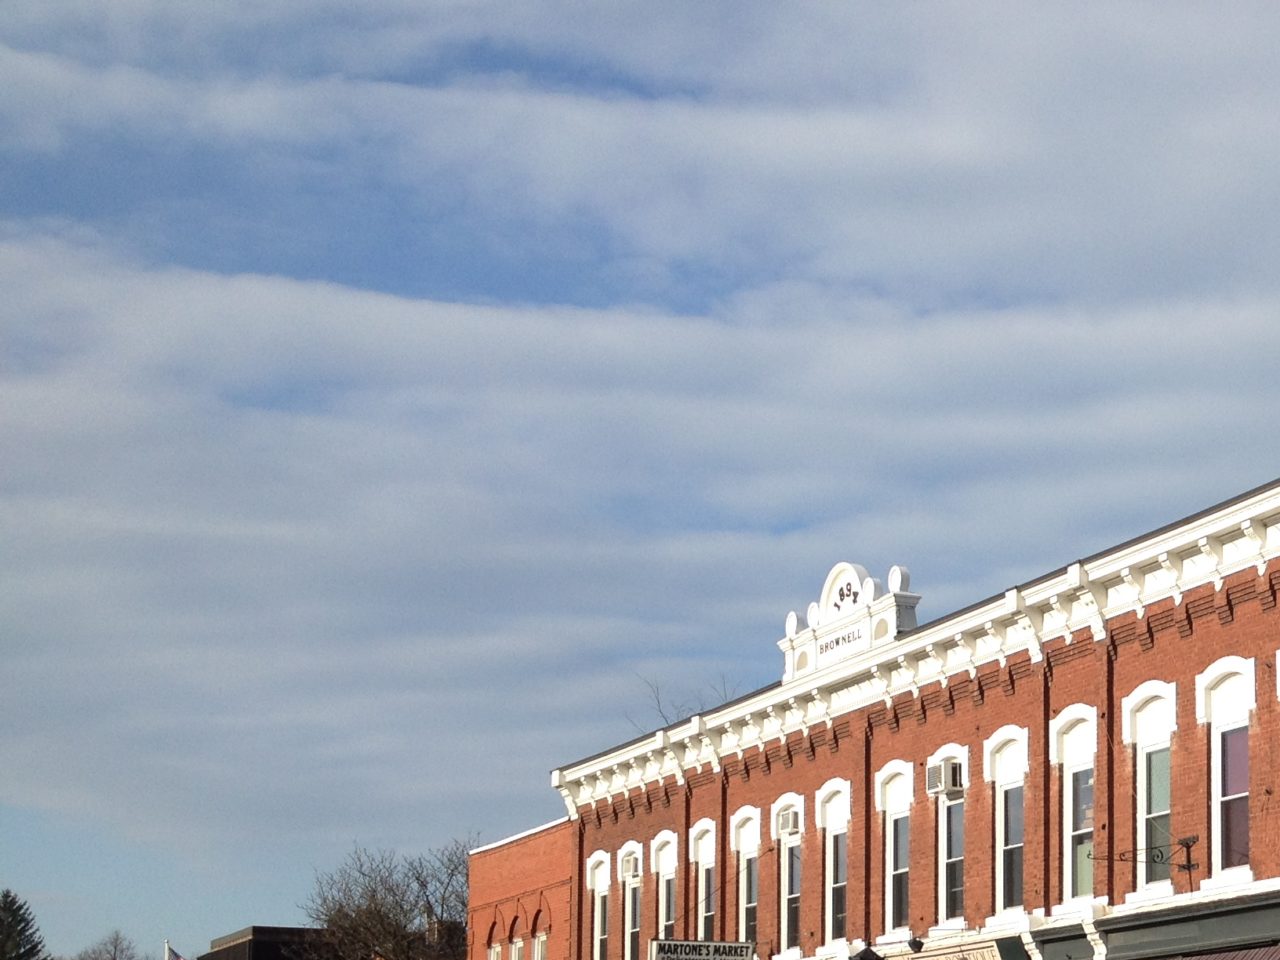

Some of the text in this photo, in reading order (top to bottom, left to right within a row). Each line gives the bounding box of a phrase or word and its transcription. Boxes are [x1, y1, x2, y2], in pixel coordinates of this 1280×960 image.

[819, 629, 862, 655] BROWNELL
[657, 943, 750, 957] MARTONE'S MARKET
